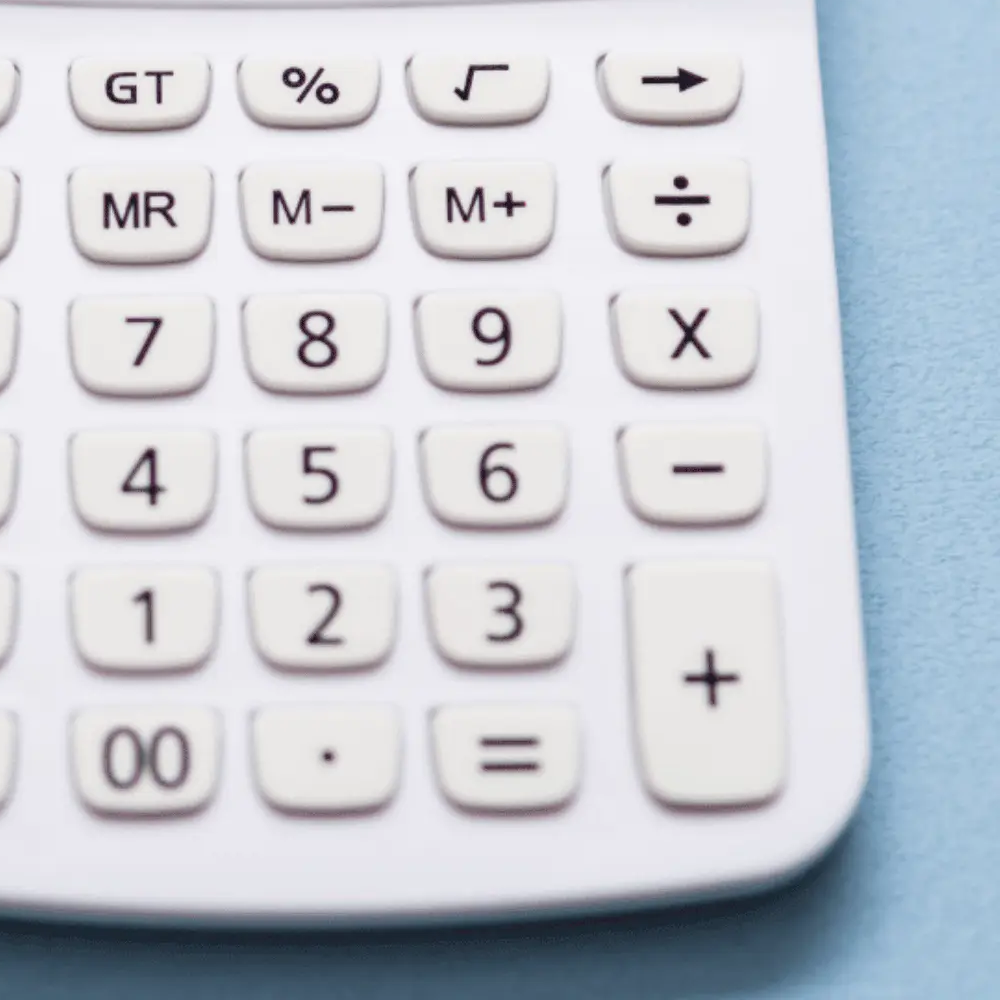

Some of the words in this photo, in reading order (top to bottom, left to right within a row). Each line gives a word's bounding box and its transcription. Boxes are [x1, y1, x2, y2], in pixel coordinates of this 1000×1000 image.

[105, 71, 174, 105] GT
[282, 67, 340, 105] %
[103, 191, 177, 229] MR
[445, 186, 526, 223] M+
[125, 317, 163, 367] 7
[297, 310, 338, 369] 8
[471, 307, 512, 367] 9
[121, 447, 164, 506] 4
[302, 446, 339, 505] 5
[478, 442, 518, 503] 6
[133, 590, 156, 643] 1
[306, 584, 342, 645] 2
[487, 581, 525, 643] 3
[684, 651, 739, 706] +
[102, 727, 191, 790] 00
[481, 738, 539, 773] =
